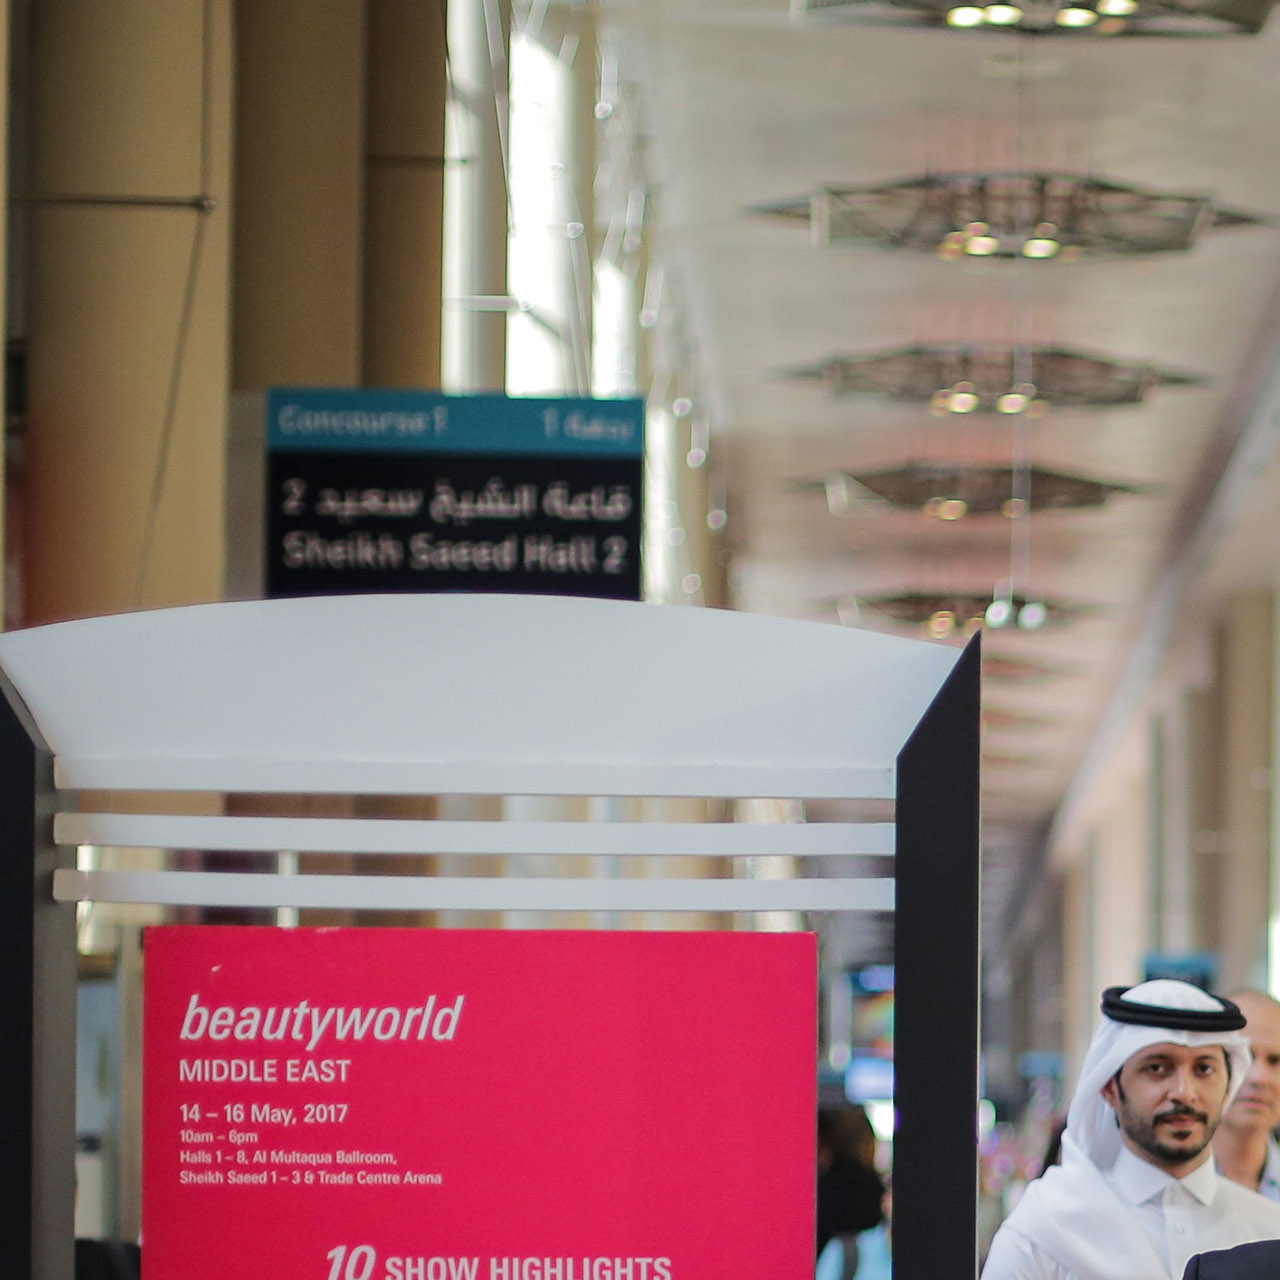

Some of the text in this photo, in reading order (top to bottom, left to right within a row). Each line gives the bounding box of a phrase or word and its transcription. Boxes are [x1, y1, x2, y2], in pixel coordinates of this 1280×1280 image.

[543, 481, 632, 522] قاعة
[283, 530, 628, 574] Sheikh Saeed Hall 2
[179, 993, 465, 1050] beautyworld
[179, 1058, 352, 1083] MIDDLE EAST
[179, 1103, 201, 1123] 14
[223, 1103, 246, 1123] 16
[250, 1103, 297, 1126] May,
[303, 1103, 349, 1124] 2017
[179, 1129, 214, 1144] 10am
[228, 1128, 259, 1146] 6pm
[179, 1150, 213, 1164] Halls
[215, 1150, 222, 1163] 1
[236, 1149, 249, 1165] 8,
[252, 1150, 267, 1164] Al
[270, 1149, 333, 1166] Multaqua
[335, 1149, 397, 1165] Ballroom,
[179, 1170, 224, 1184] Sheikh
[227, 1170, 268, 1185] Saeed
[270, 1170, 277, 1184] 1
[291, 1170, 301, 1185] 3
[303, 1170, 315, 1185] &
[317, 1170, 354, 1185] Trade
[356, 1170, 401, 1185] Centre
[403, 1170, 443, 1185] Arena
